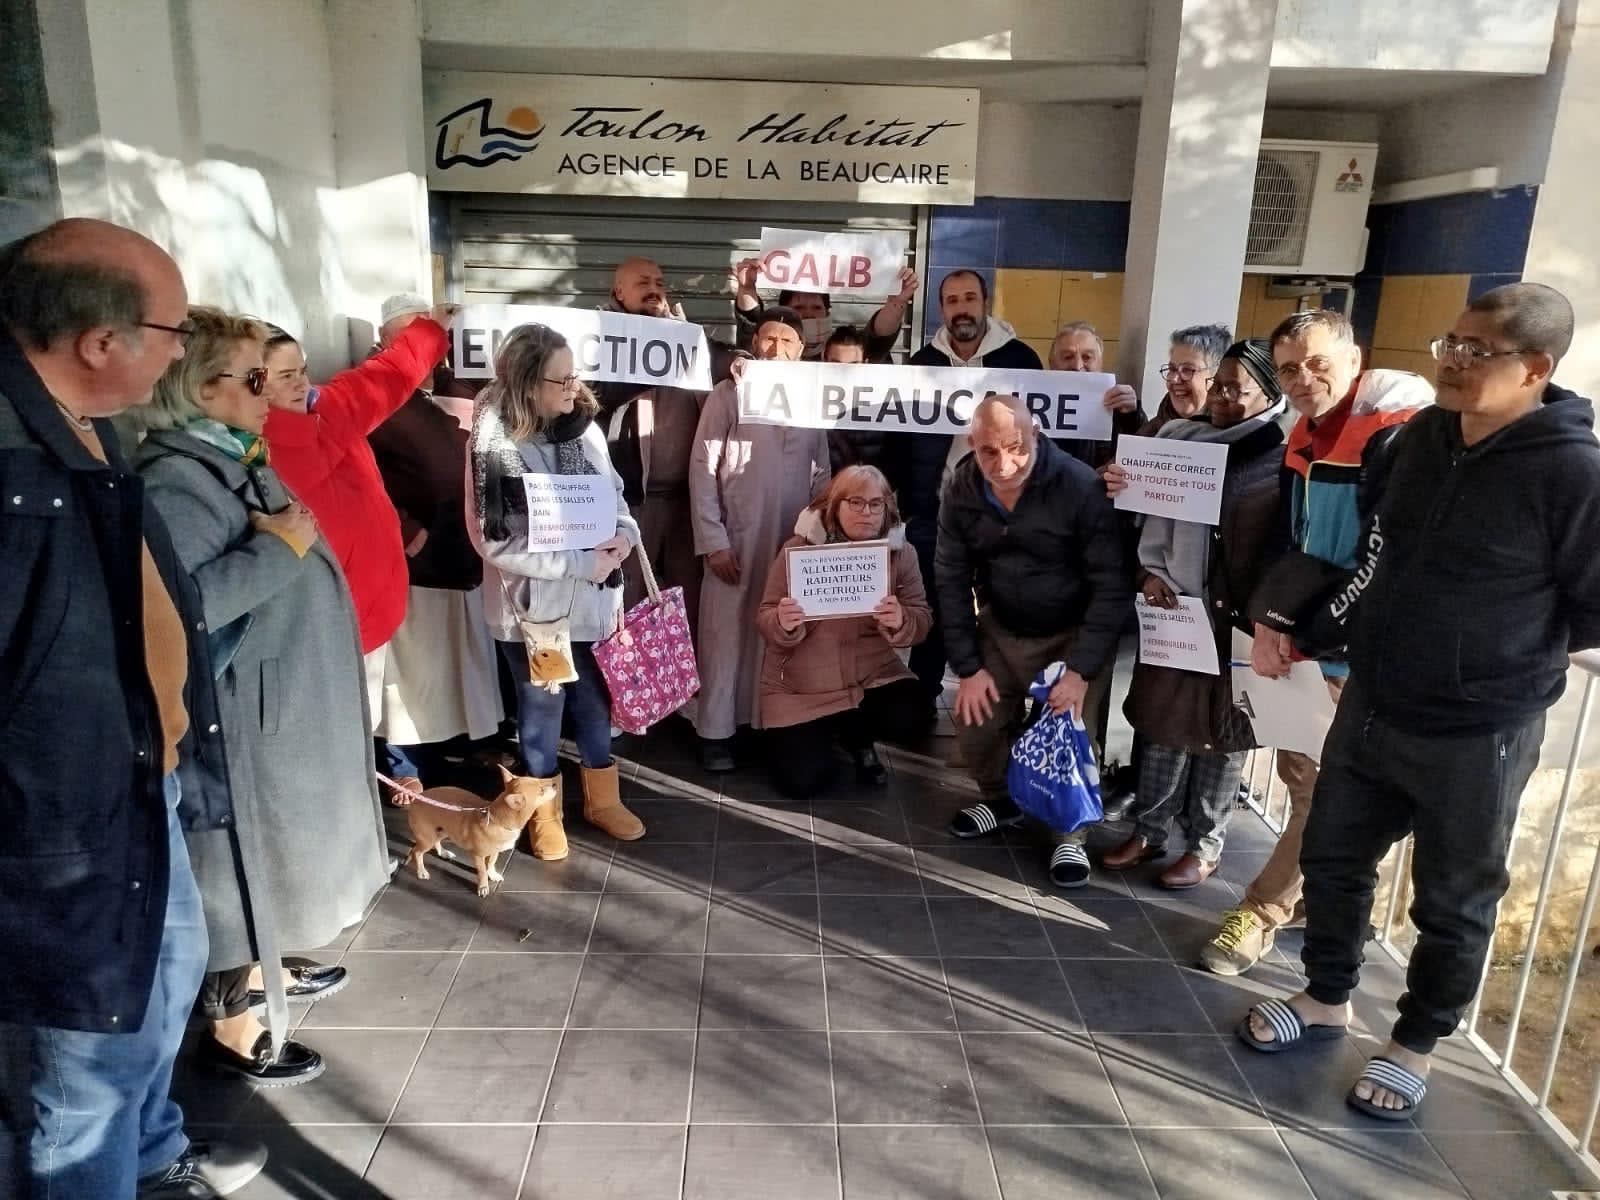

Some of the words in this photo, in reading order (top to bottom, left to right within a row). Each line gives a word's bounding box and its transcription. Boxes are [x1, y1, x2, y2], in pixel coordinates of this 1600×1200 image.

[560, 107, 711, 142] Toulon
[737, 113, 966, 147] Habitat
[558, 153, 675, 177] AGENCE
[695, 158, 728, 178] DE
[747, 159, 780, 180] LA
[800, 160, 949, 184] BEAUCAIRE
[764, 250, 871, 288] GALB
[577, 333, 698, 377] CTION
[743, 382, 792, 419] LA
[821, 385, 1079, 430] BEAUCRE
[1121, 457, 1172, 471] CHAUFFAGE
[1174, 464, 1216, 476] CORRECT
[1121, 472, 1142, 482] OUR
[1144, 475, 1177, 487] TOUTES
[1191, 481, 1216, 491] TOUS
[1144, 490, 1185, 503] PARTOUT
[532, 509, 551, 517] BAIN
[802, 564, 853, 574] ALLUMER
[855, 562, 877, 571] NOS
[806, 574, 872, 585] RADIATEURS
[803, 585, 876, 597] ELECTRIQUES
